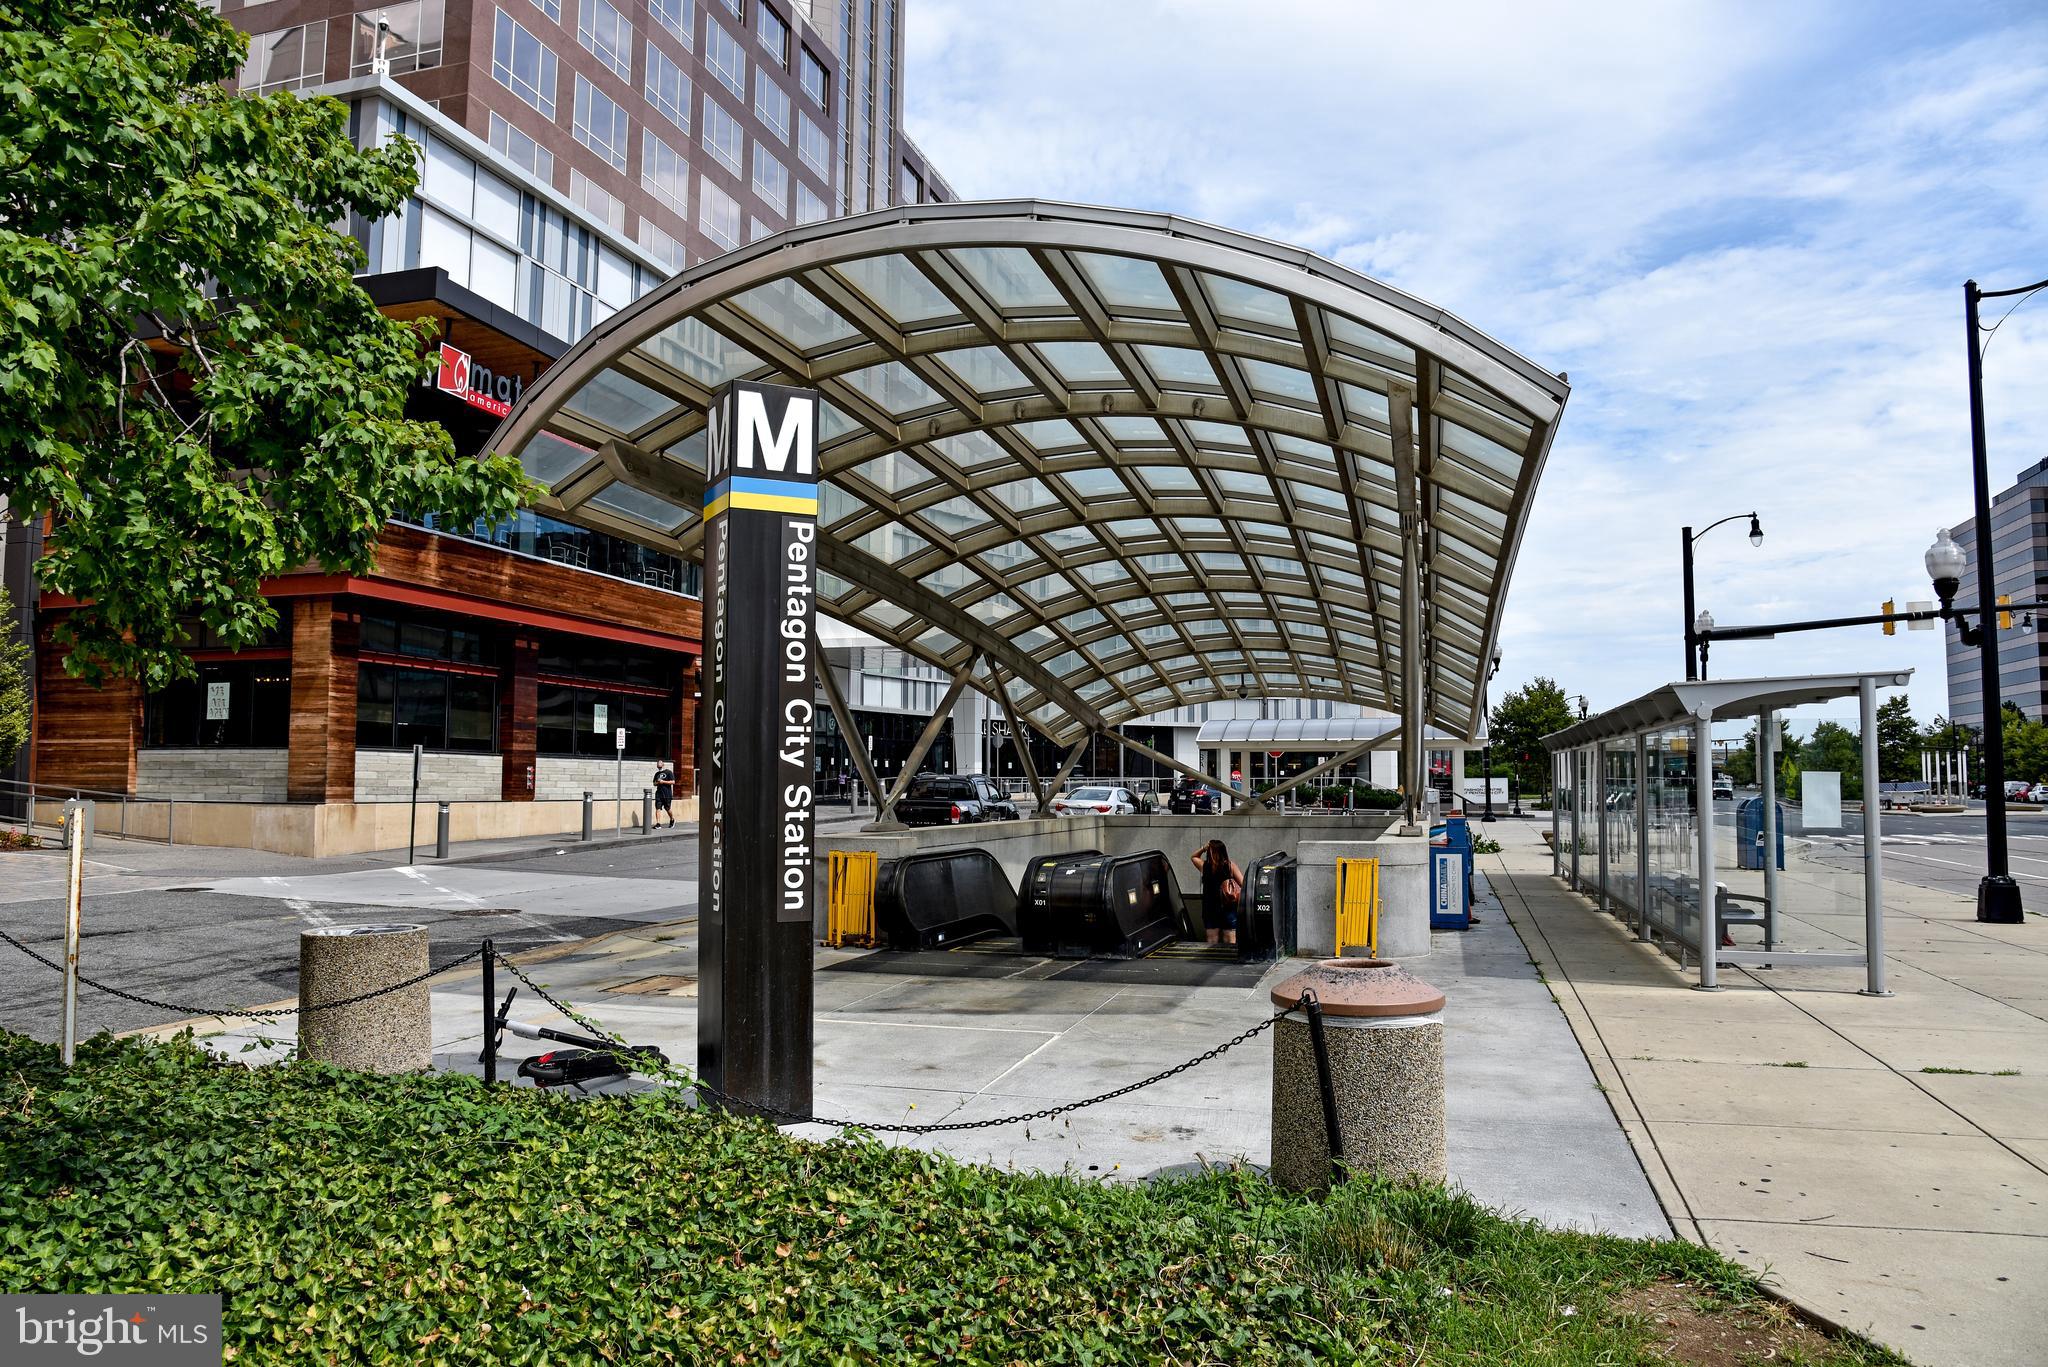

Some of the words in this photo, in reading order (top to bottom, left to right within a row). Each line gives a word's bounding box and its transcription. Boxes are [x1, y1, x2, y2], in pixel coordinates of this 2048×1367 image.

[707, 393, 730, 482] M
[737, 389, 813, 475] M
[714, 519, 728, 683] Pentagon
[780, 521, 815, 683] Pentagon
[712, 699, 724, 768] City
[780, 698, 813, 768] City
[712, 786, 723, 912] Station
[783, 784, 812, 910] Station
